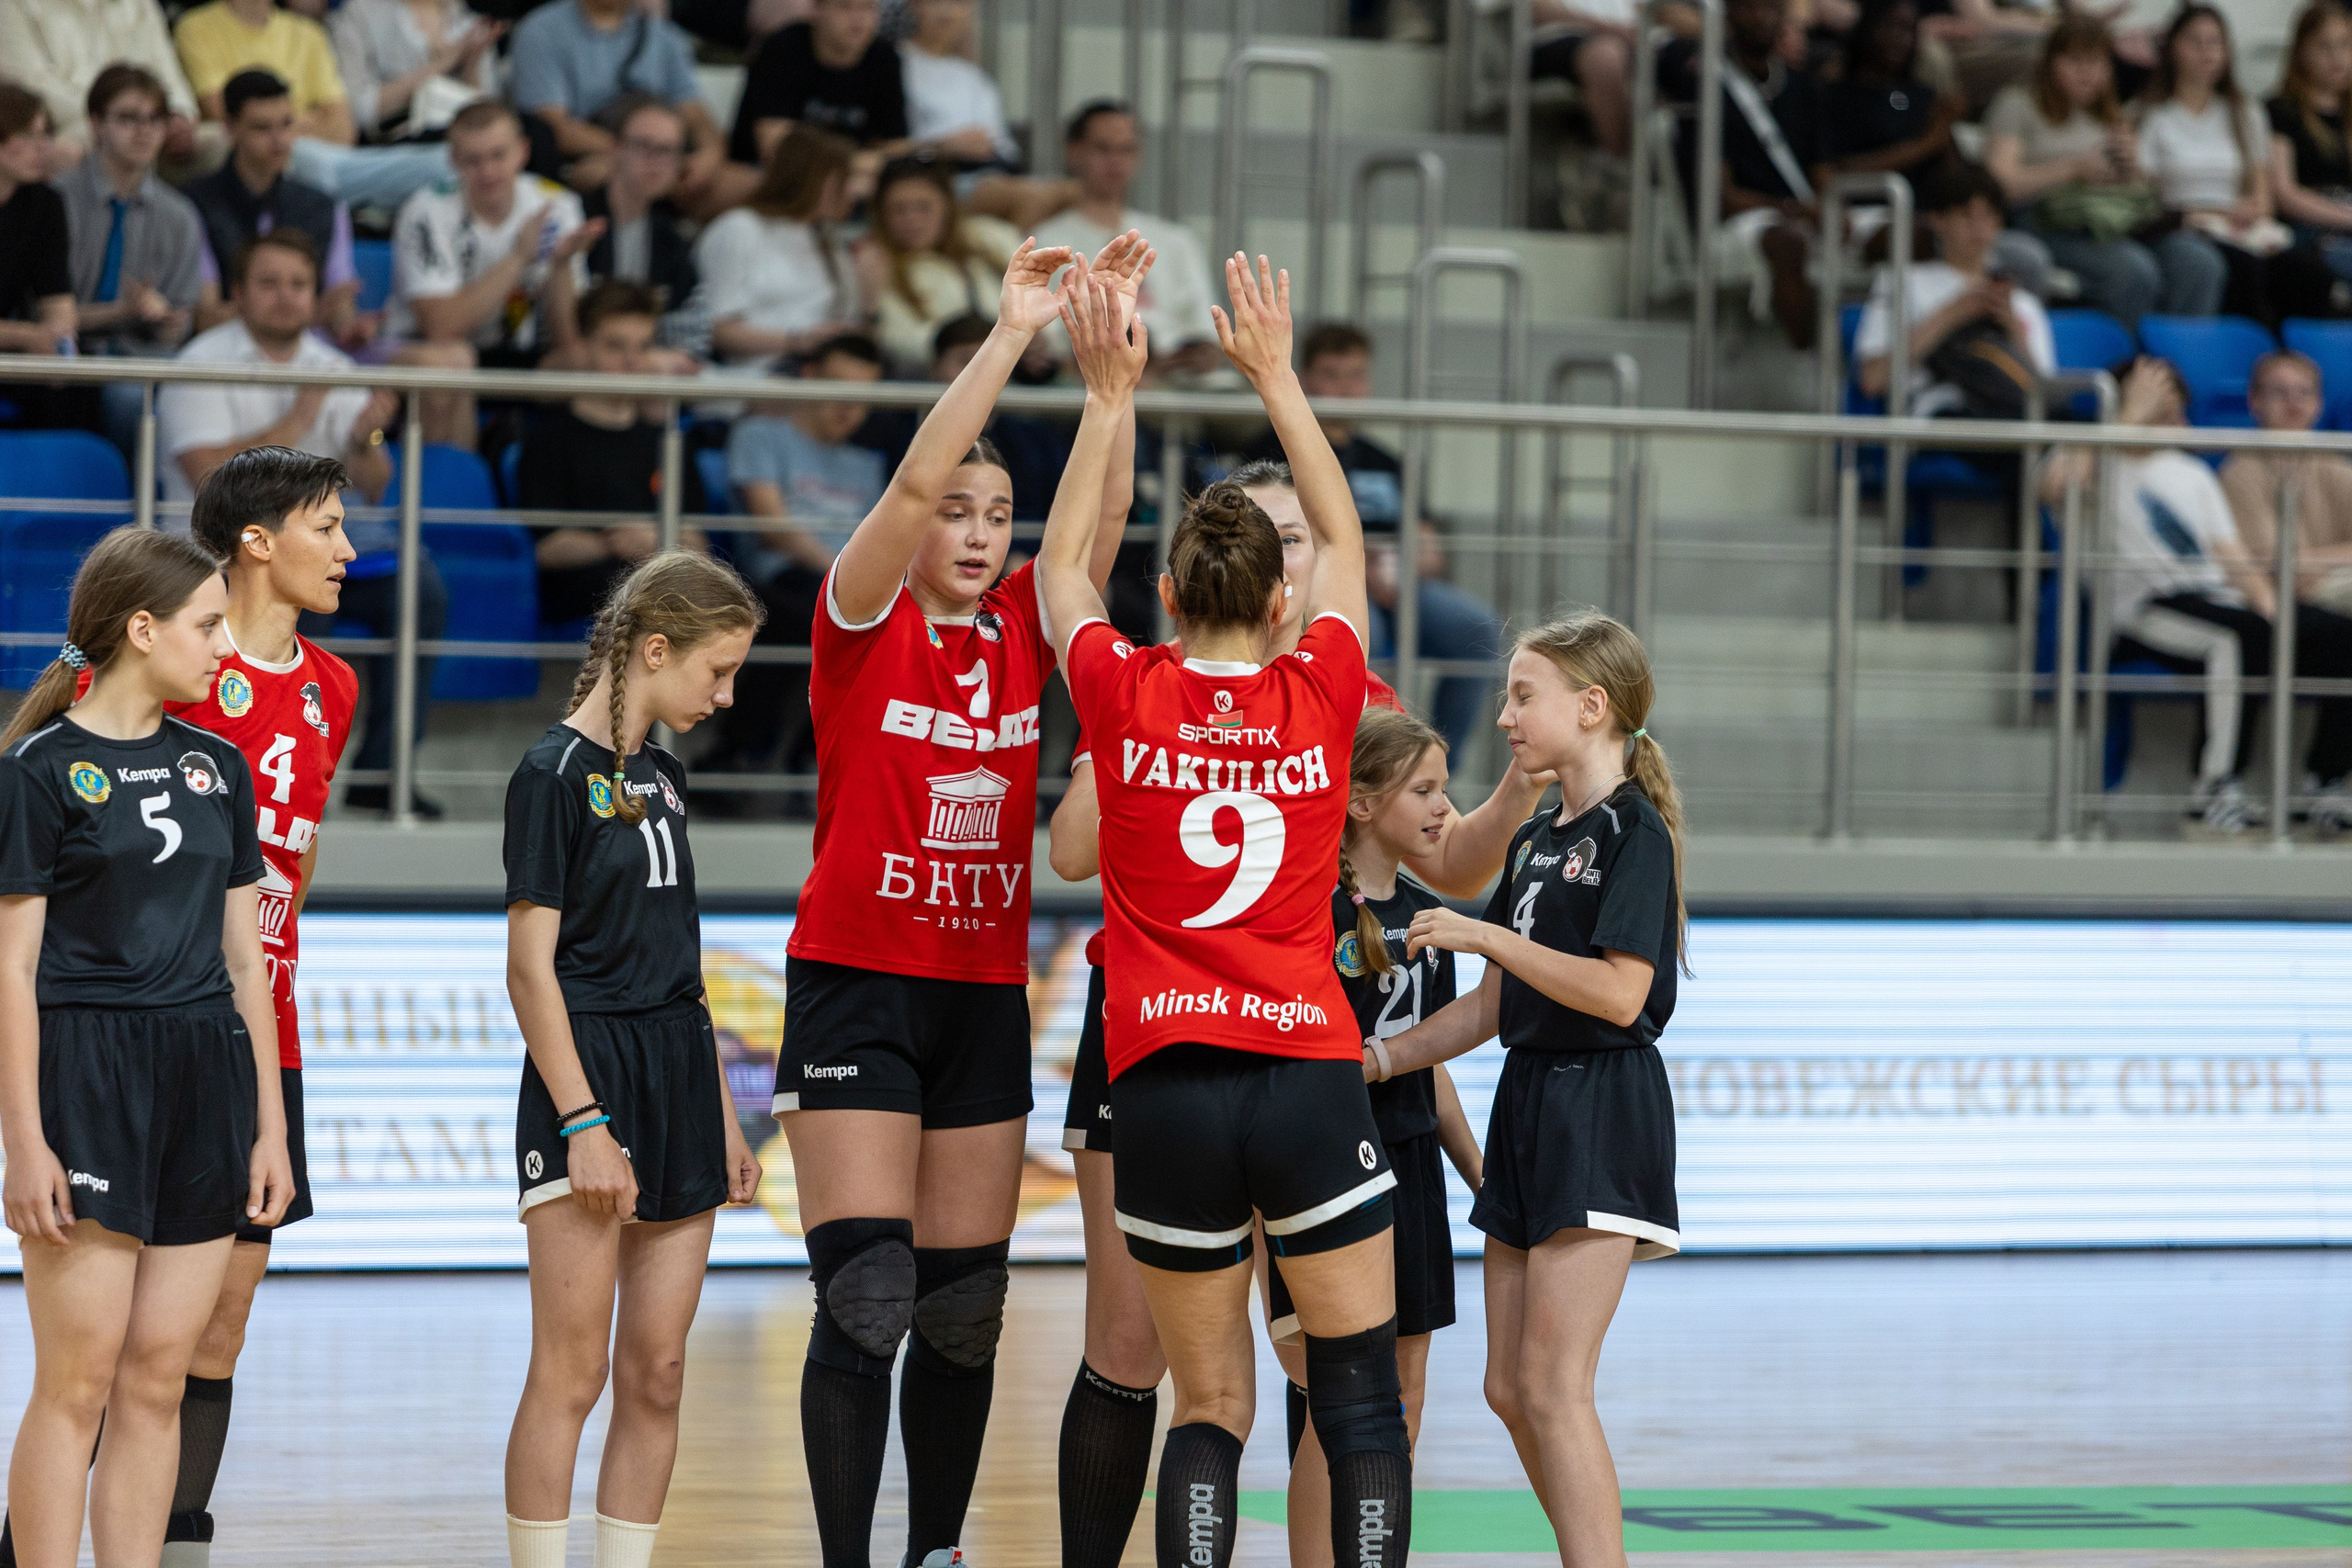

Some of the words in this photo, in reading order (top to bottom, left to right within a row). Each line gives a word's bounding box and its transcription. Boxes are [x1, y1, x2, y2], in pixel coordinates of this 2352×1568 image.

[954, 658, 990, 718] 1
[1178, 722, 1282, 750] SPORTIX
[117, 767, 172, 784] Kempa
[259, 733, 296, 805] 4
[623, 780, 659, 798] Kempa
[1123, 739, 1330, 795] VAKULICH
[140, 790, 183, 863] 5
[638, 816, 678, 888] 11
[876, 852, 1023, 908] БНТУ
[1180, 792, 1286, 929] 9
[937, 916, 980, 931] 1920
[1512, 882, 1544, 941] 4
[1140, 987, 1230, 1023] Minsk
[1240, 993, 1328, 1032] Region
[1374, 961, 1422, 1040] 21
[803, 1064, 858, 1081] Kempa
[2115, 1055, 2330, 1117] СЫРЫ
